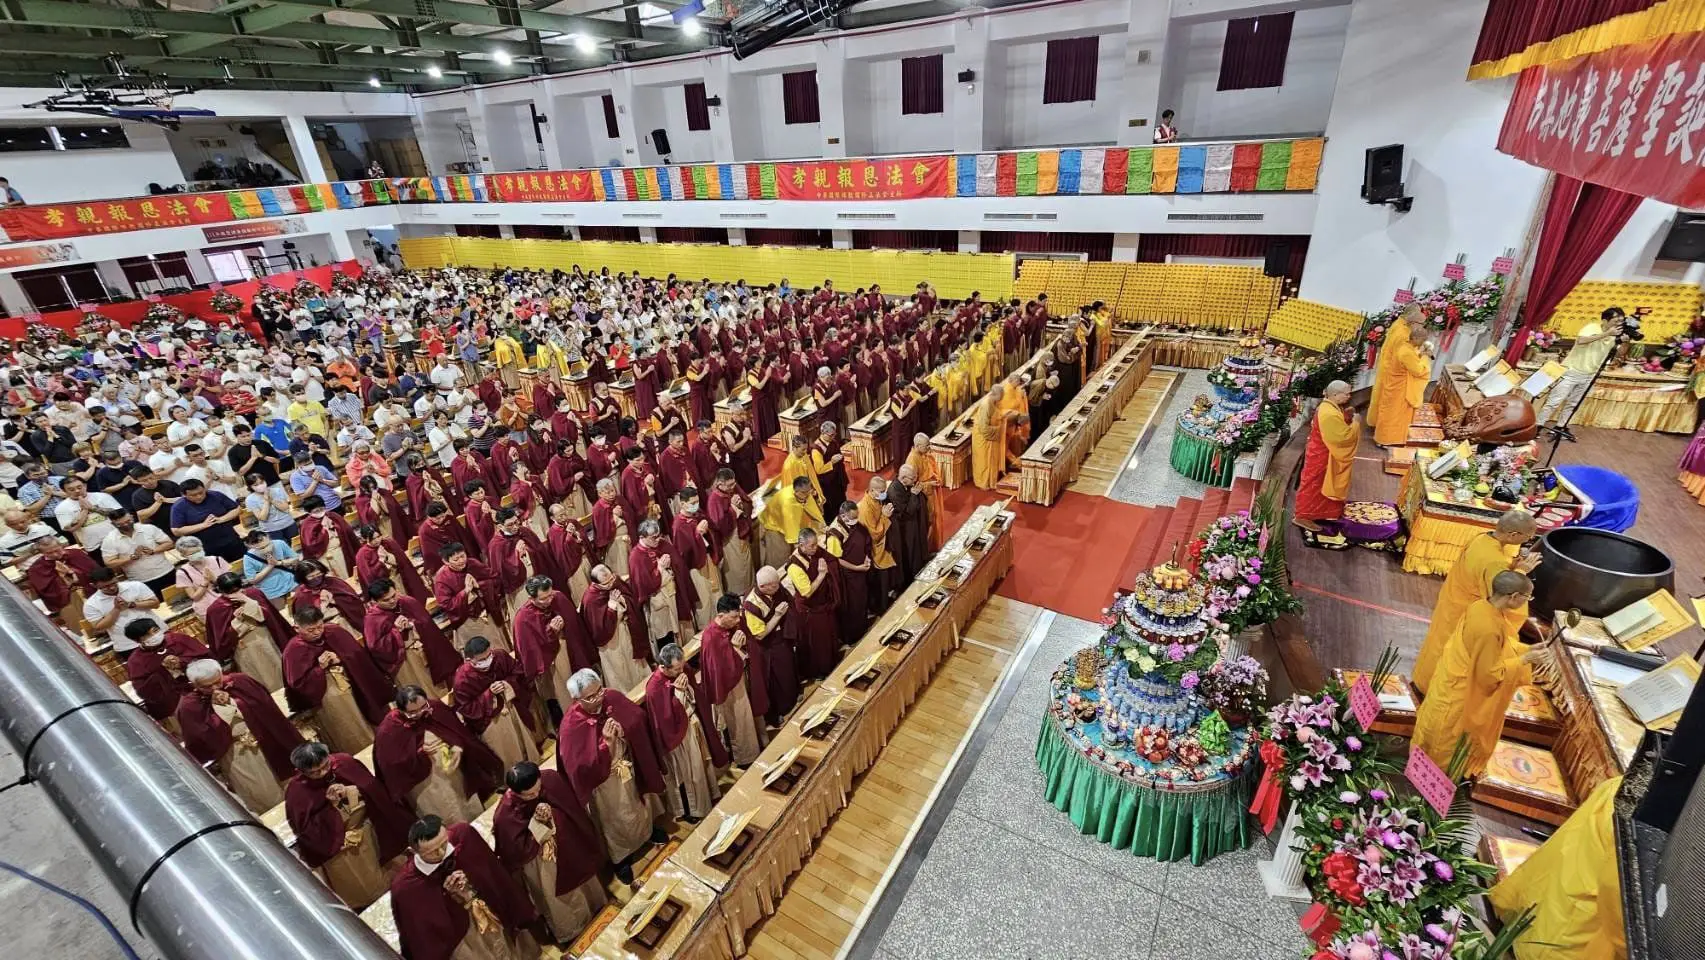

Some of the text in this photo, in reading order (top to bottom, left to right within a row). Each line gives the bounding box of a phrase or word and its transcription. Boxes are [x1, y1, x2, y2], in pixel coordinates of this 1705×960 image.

[1526, 60, 1705, 168] 南無地藏菩薩聖誕
[791, 162, 931, 189] 孝親報恩法會
[44, 196, 213, 228] 孝親報恩法會
